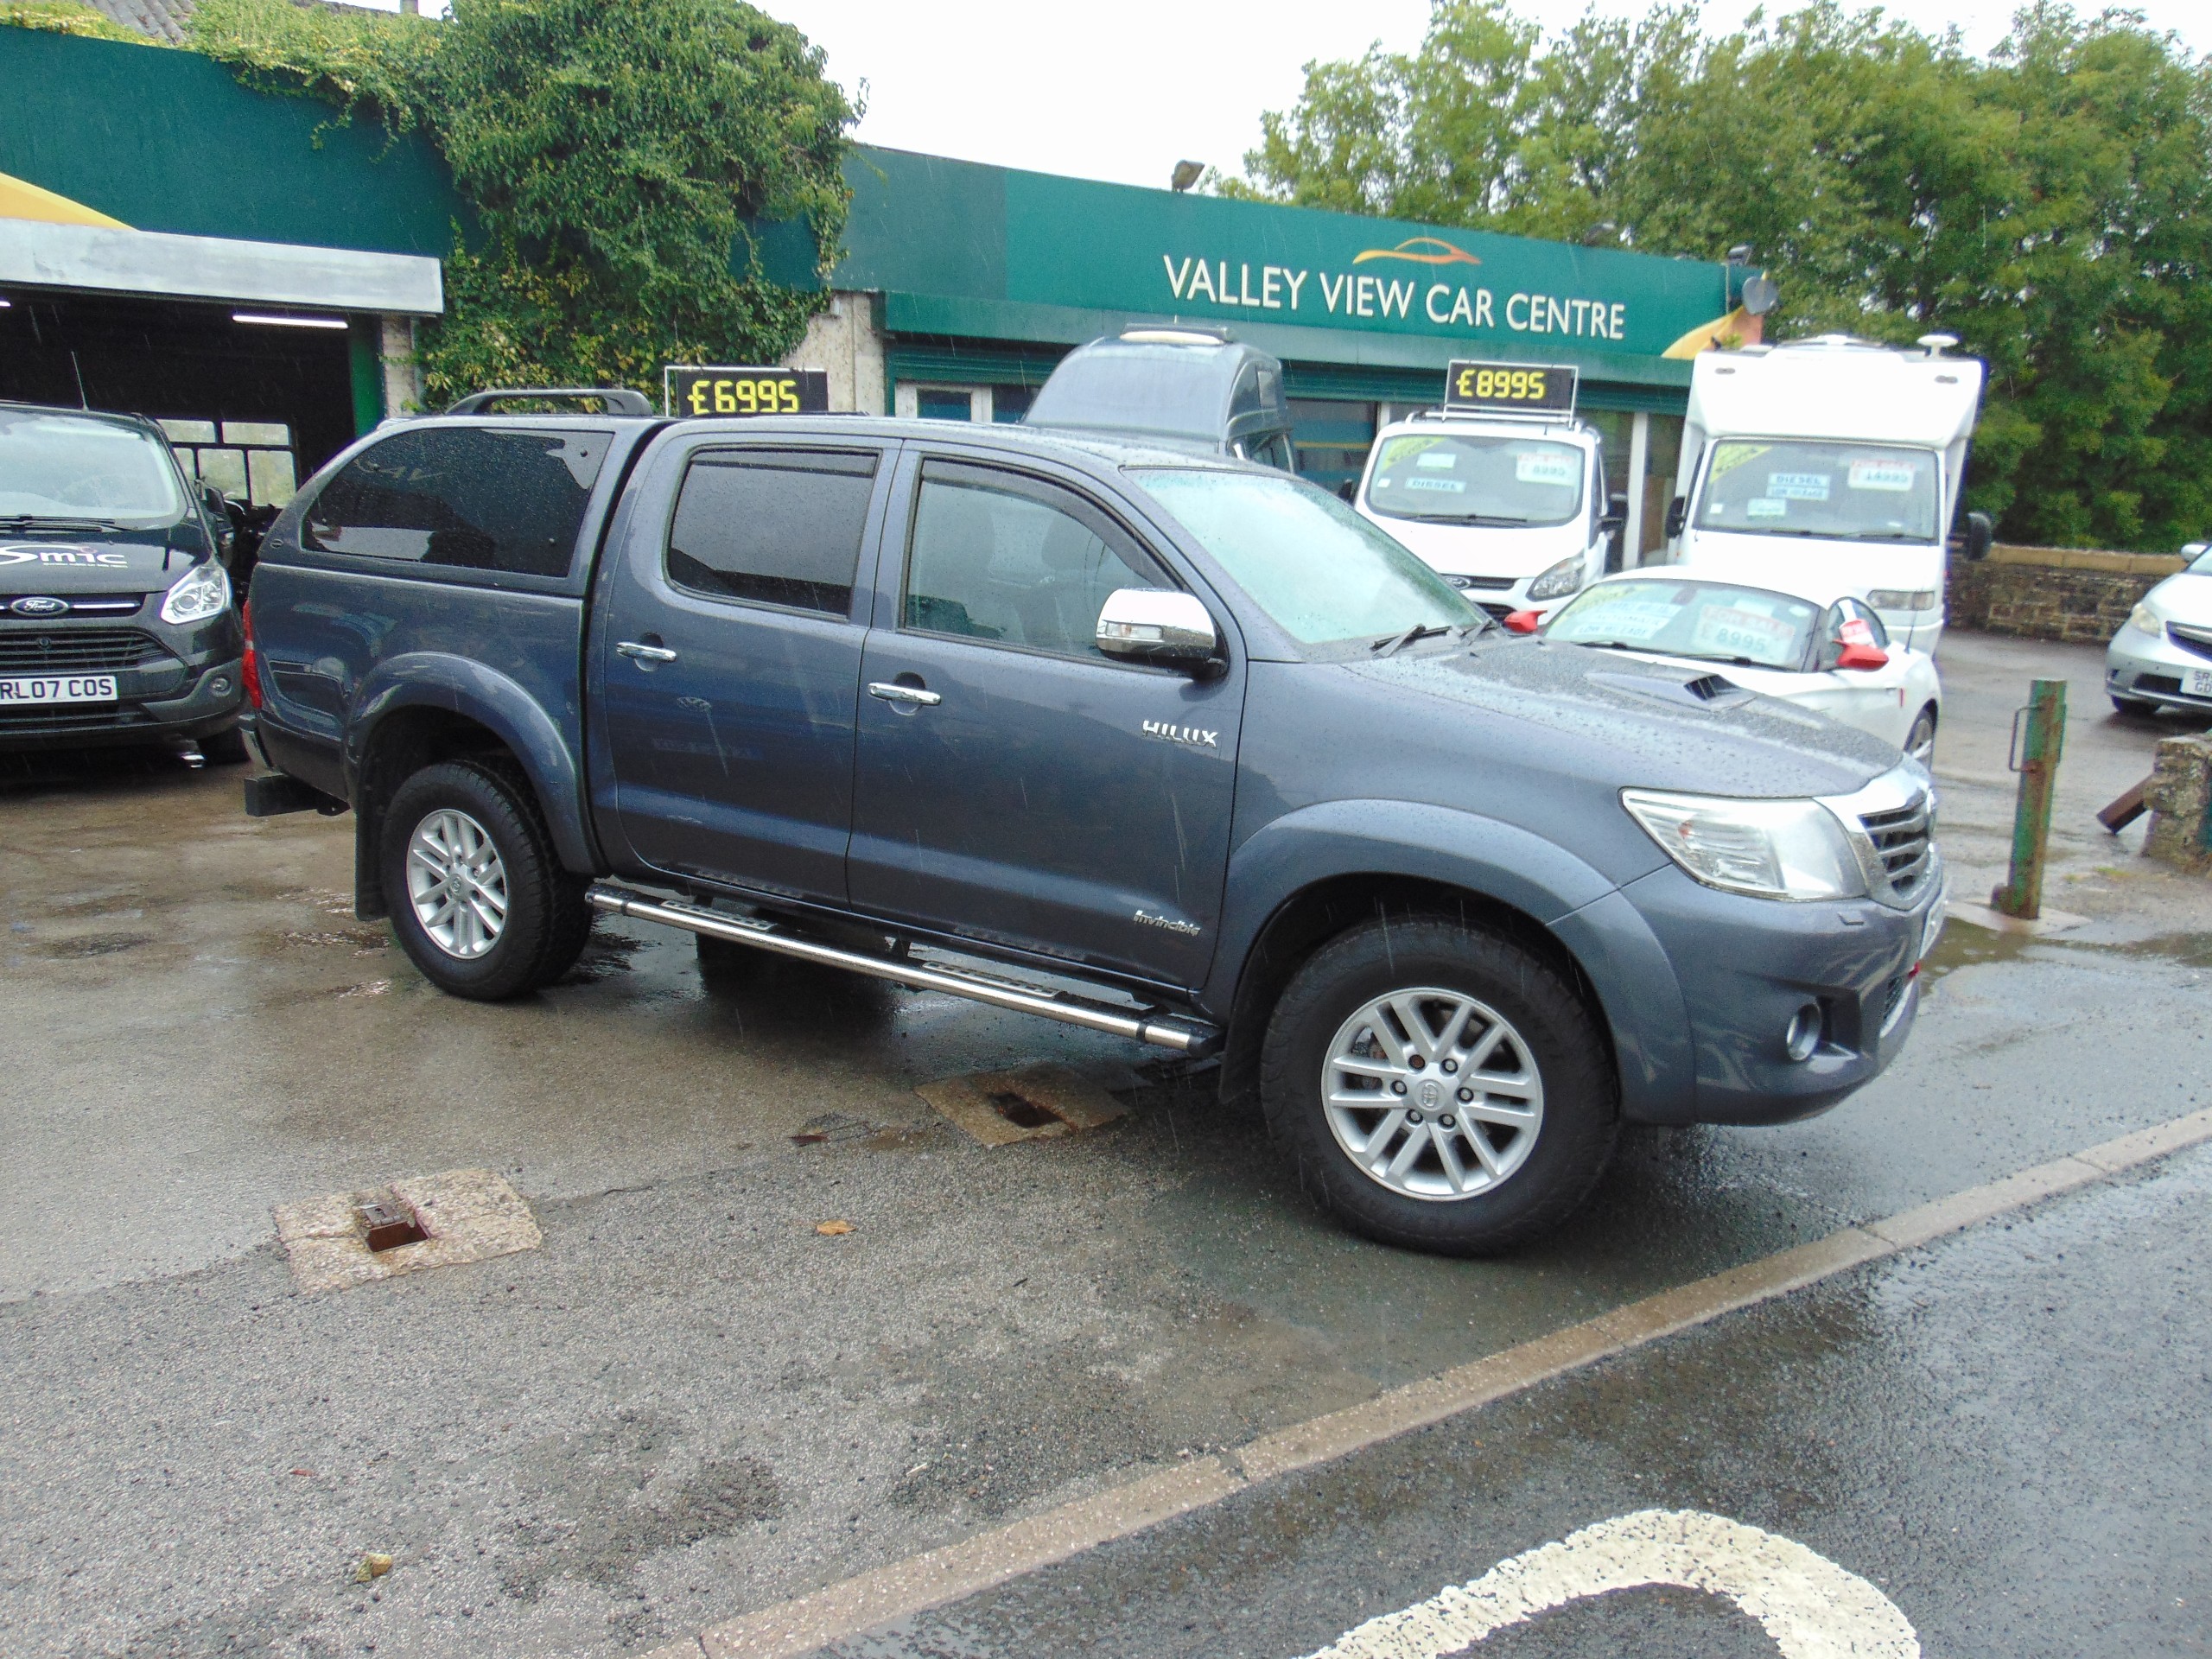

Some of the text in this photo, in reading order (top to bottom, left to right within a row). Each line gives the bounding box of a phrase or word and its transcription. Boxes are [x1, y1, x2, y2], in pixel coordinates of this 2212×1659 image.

[1163, 255, 1625, 340] VALLEY VIEW CAR CENTRE
[1456, 370, 1546, 399] £8995
[687, 380, 798, 415] £6995
[1412, 480, 1457, 491] DIESEL
[1777, 475, 1821, 485] DIESEL
[23, 600, 55, 612] Ford
[1578, 625, 1601, 633] LOW
[1707, 606, 1796, 637] FOR SALE
[1716, 628, 1765, 653] 8995
[2194, 671, 2212, 681] SR
[0, 678, 113, 700] RL07 COS
[1142, 720, 1218, 748] HILUX
[1133, 910, 1201, 937] Invincible
